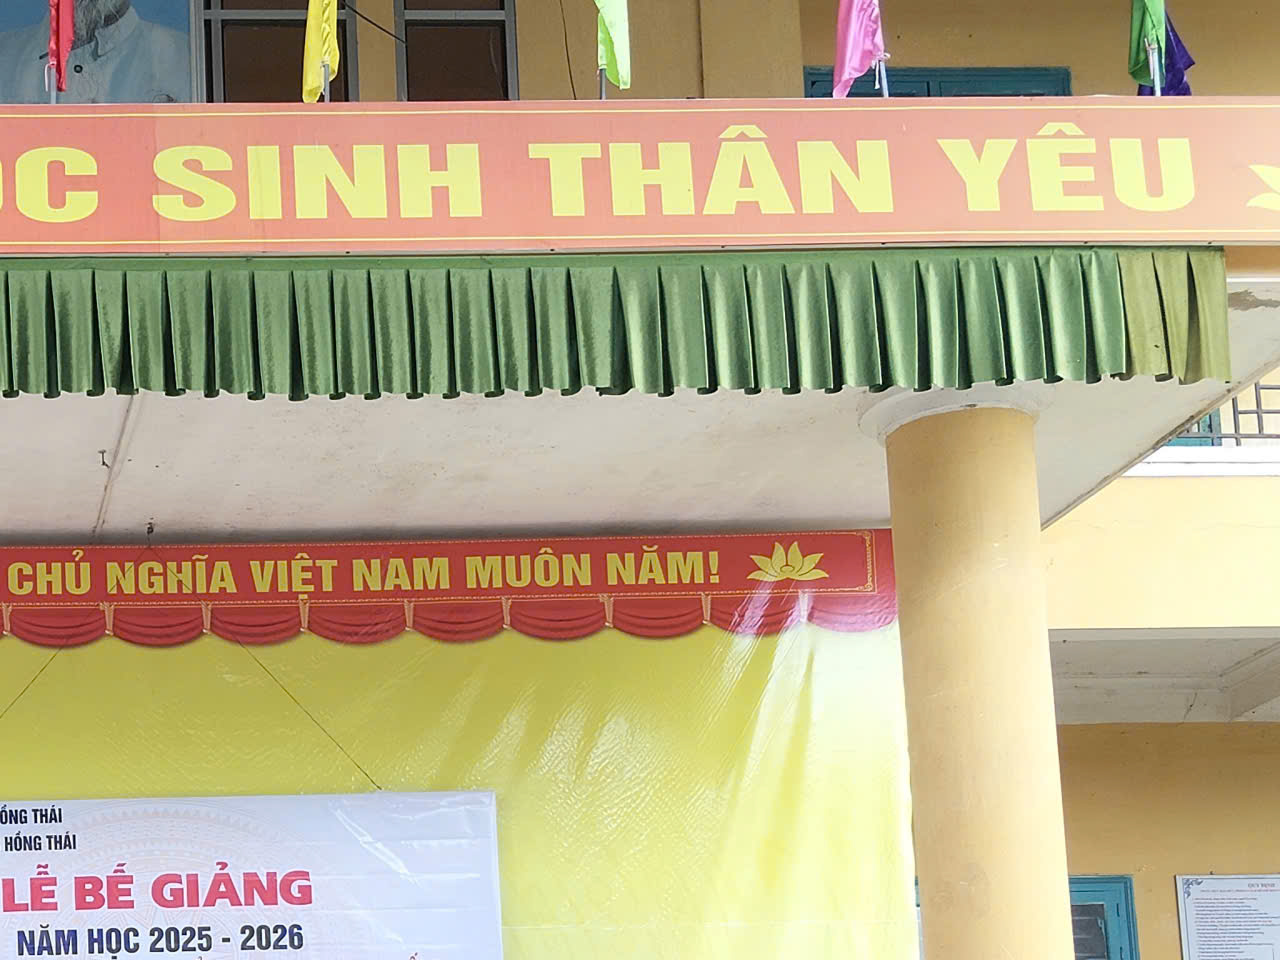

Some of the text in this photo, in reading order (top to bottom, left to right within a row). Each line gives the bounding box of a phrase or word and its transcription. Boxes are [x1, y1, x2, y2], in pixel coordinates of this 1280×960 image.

[152, 144, 482, 222] SINH
[528, 124, 894, 216] THÂN
[937, 121, 1195, 212] YÊU
[7, 549, 92, 595] CHỦ
[106, 554, 237, 594] NGHĨA
[249, 552, 338, 600] VIỆT
[352, 557, 450, 591] NAM
[465, 547, 591, 589] MUÔN
[606, 544, 720, 585] NĂM!
[31, 804, 63, 824] THÁI
[46, 830, 77, 850] THÁI
[1, 861, 312, 912] LỄ BẾ GIẢNG
[17, 924, 78, 956] NĂM
[88, 926, 139, 959] HỌC
[149, 925, 212, 952] 2025
[240, 923, 304, 950] 2026
